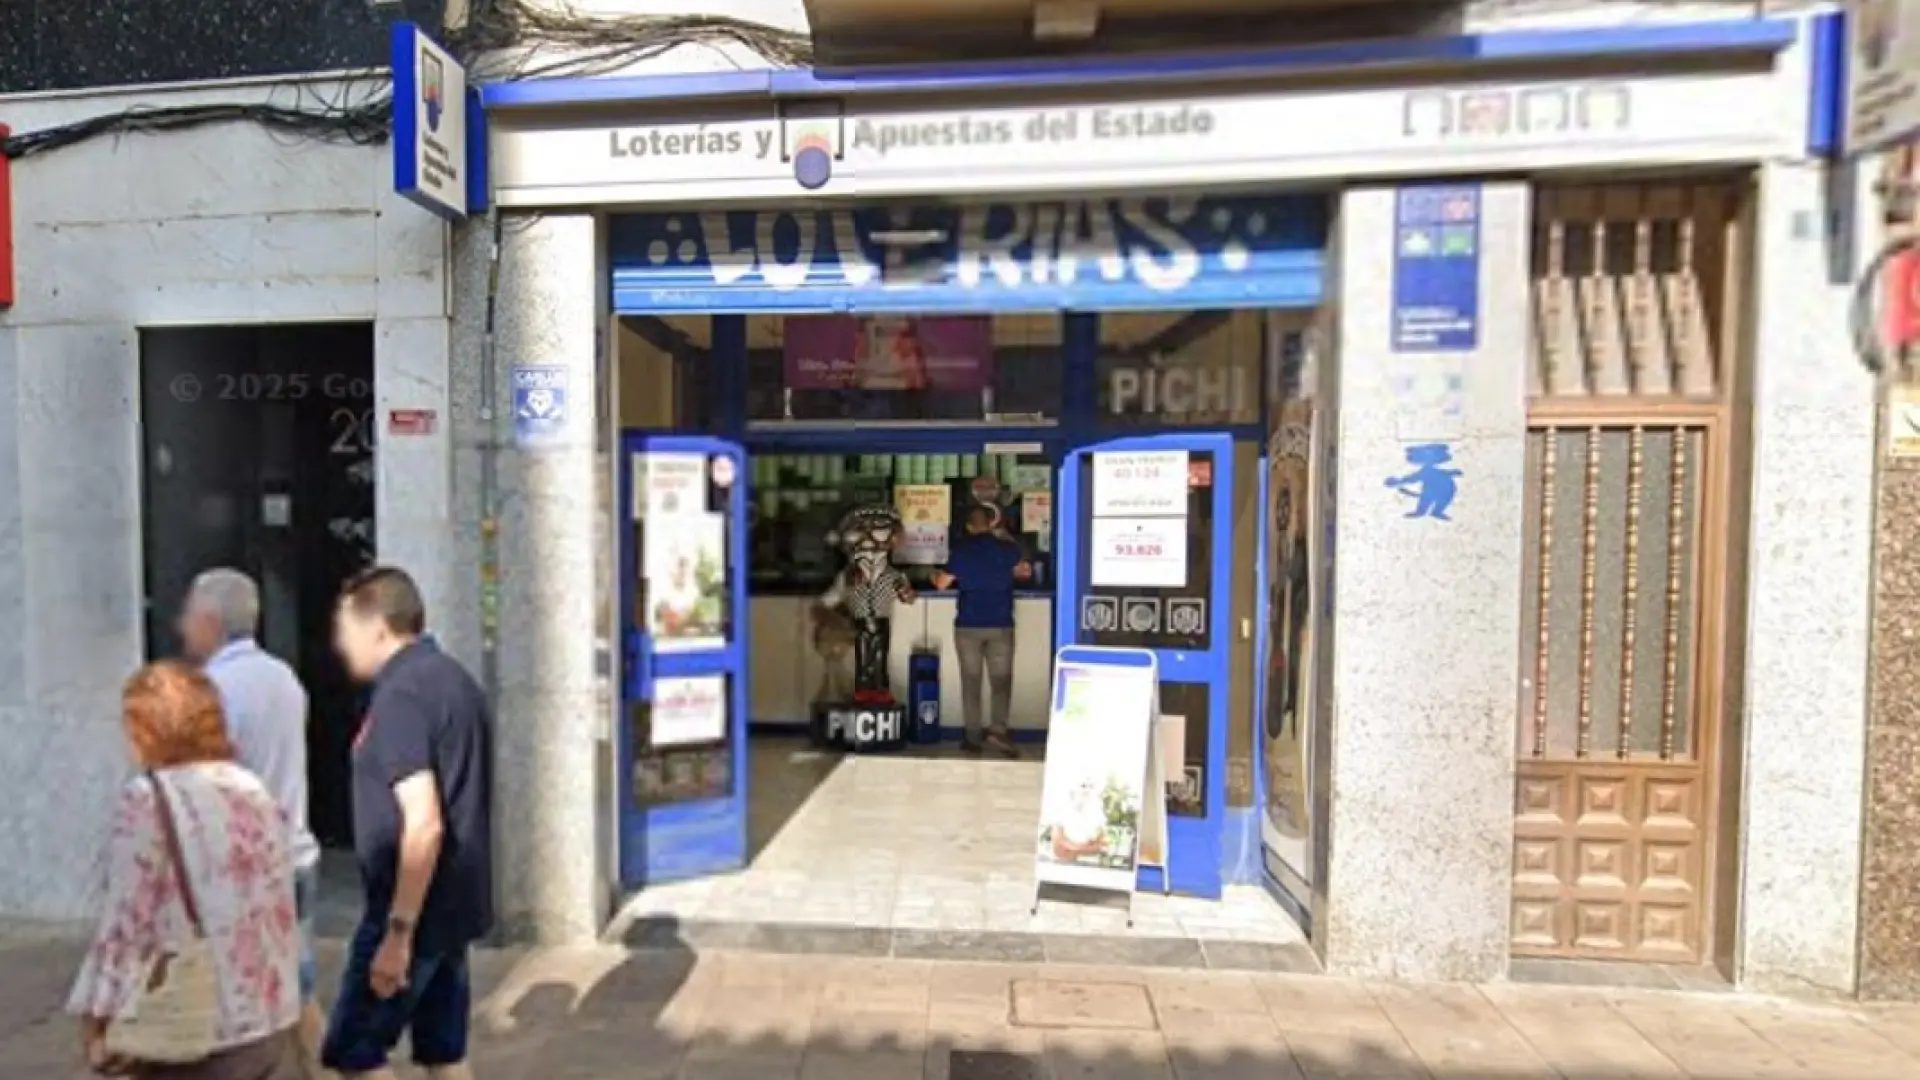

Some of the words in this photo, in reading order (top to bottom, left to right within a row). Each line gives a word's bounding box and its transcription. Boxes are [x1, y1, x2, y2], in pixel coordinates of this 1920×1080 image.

[609, 124, 742, 158] Loterías
[755, 129, 773, 160] y
[851, 107, 1012, 156] Apuestas
[1023, 102, 1078, 144] del
[1093, 95, 1215, 139] Estado
[1110, 366, 1247, 415] PICHI
